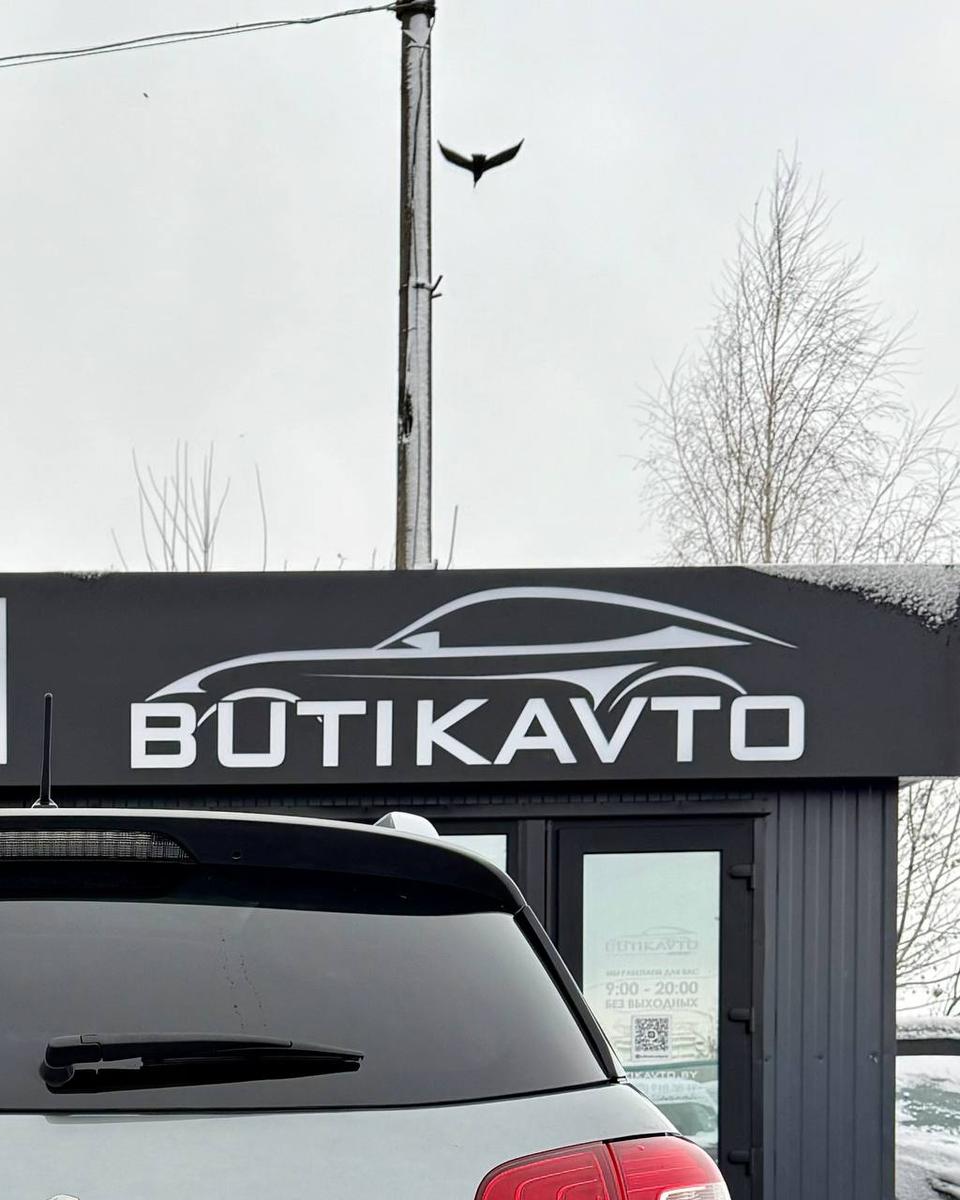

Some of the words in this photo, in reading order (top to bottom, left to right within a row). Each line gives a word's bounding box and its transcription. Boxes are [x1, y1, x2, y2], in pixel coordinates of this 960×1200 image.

[130, 695, 806, 769] BUTIKAVTO
[606, 981, 639, 995] 9:00
[655, 981, 698, 995] 20:00
